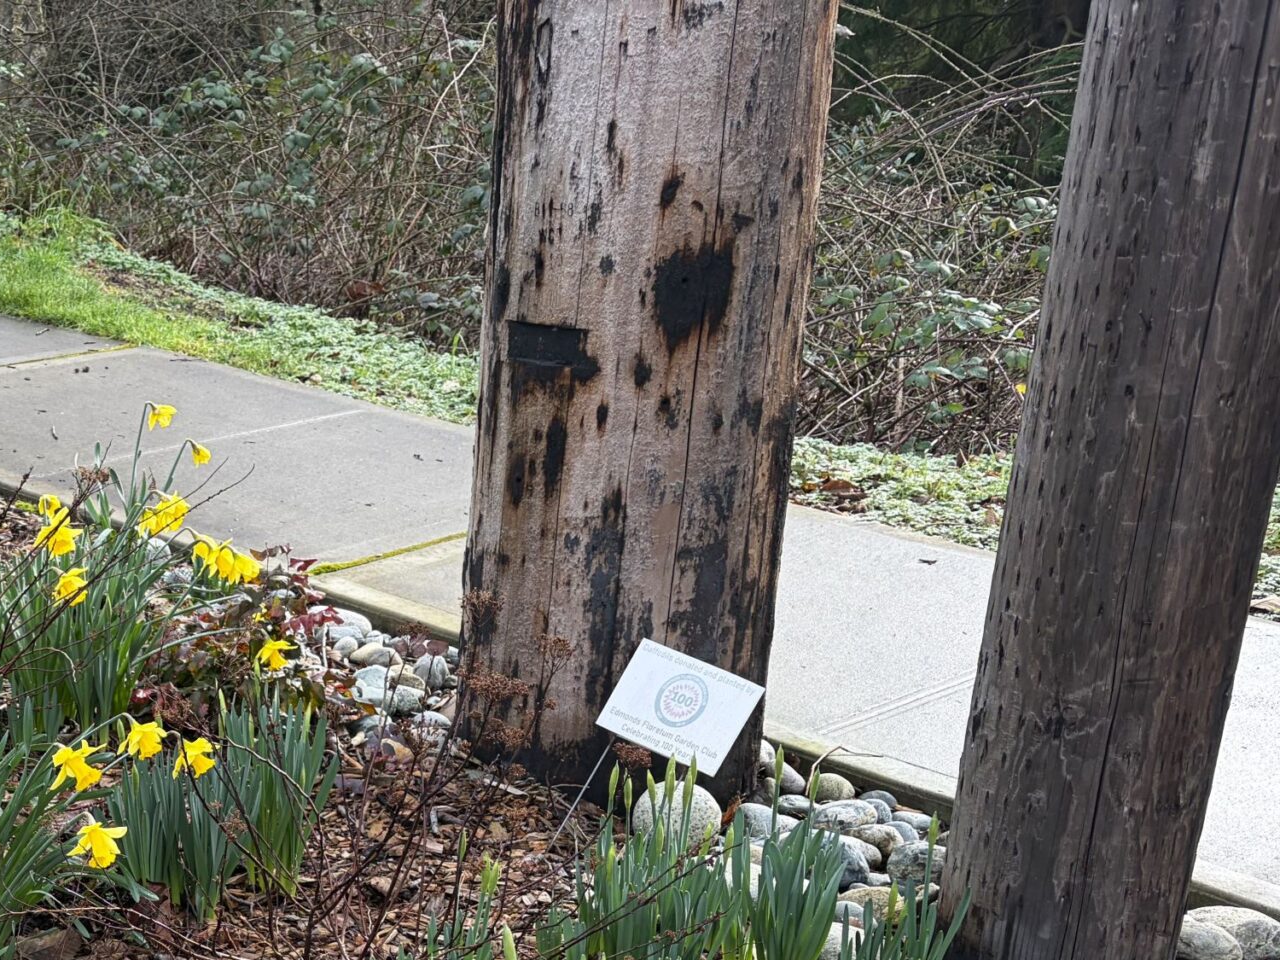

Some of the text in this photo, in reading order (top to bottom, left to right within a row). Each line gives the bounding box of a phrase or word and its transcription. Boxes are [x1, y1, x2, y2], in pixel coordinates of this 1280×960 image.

[642, 643, 756, 697] Daffodils donated and planted by
[670, 691, 694, 708] 100
[609, 705, 641, 726] Edmonds
[674, 735, 700, 751] Garden
[701, 746, 718, 760] Club
[621, 723, 660, 748] Celebrating
[661, 741, 673, 752] 100
